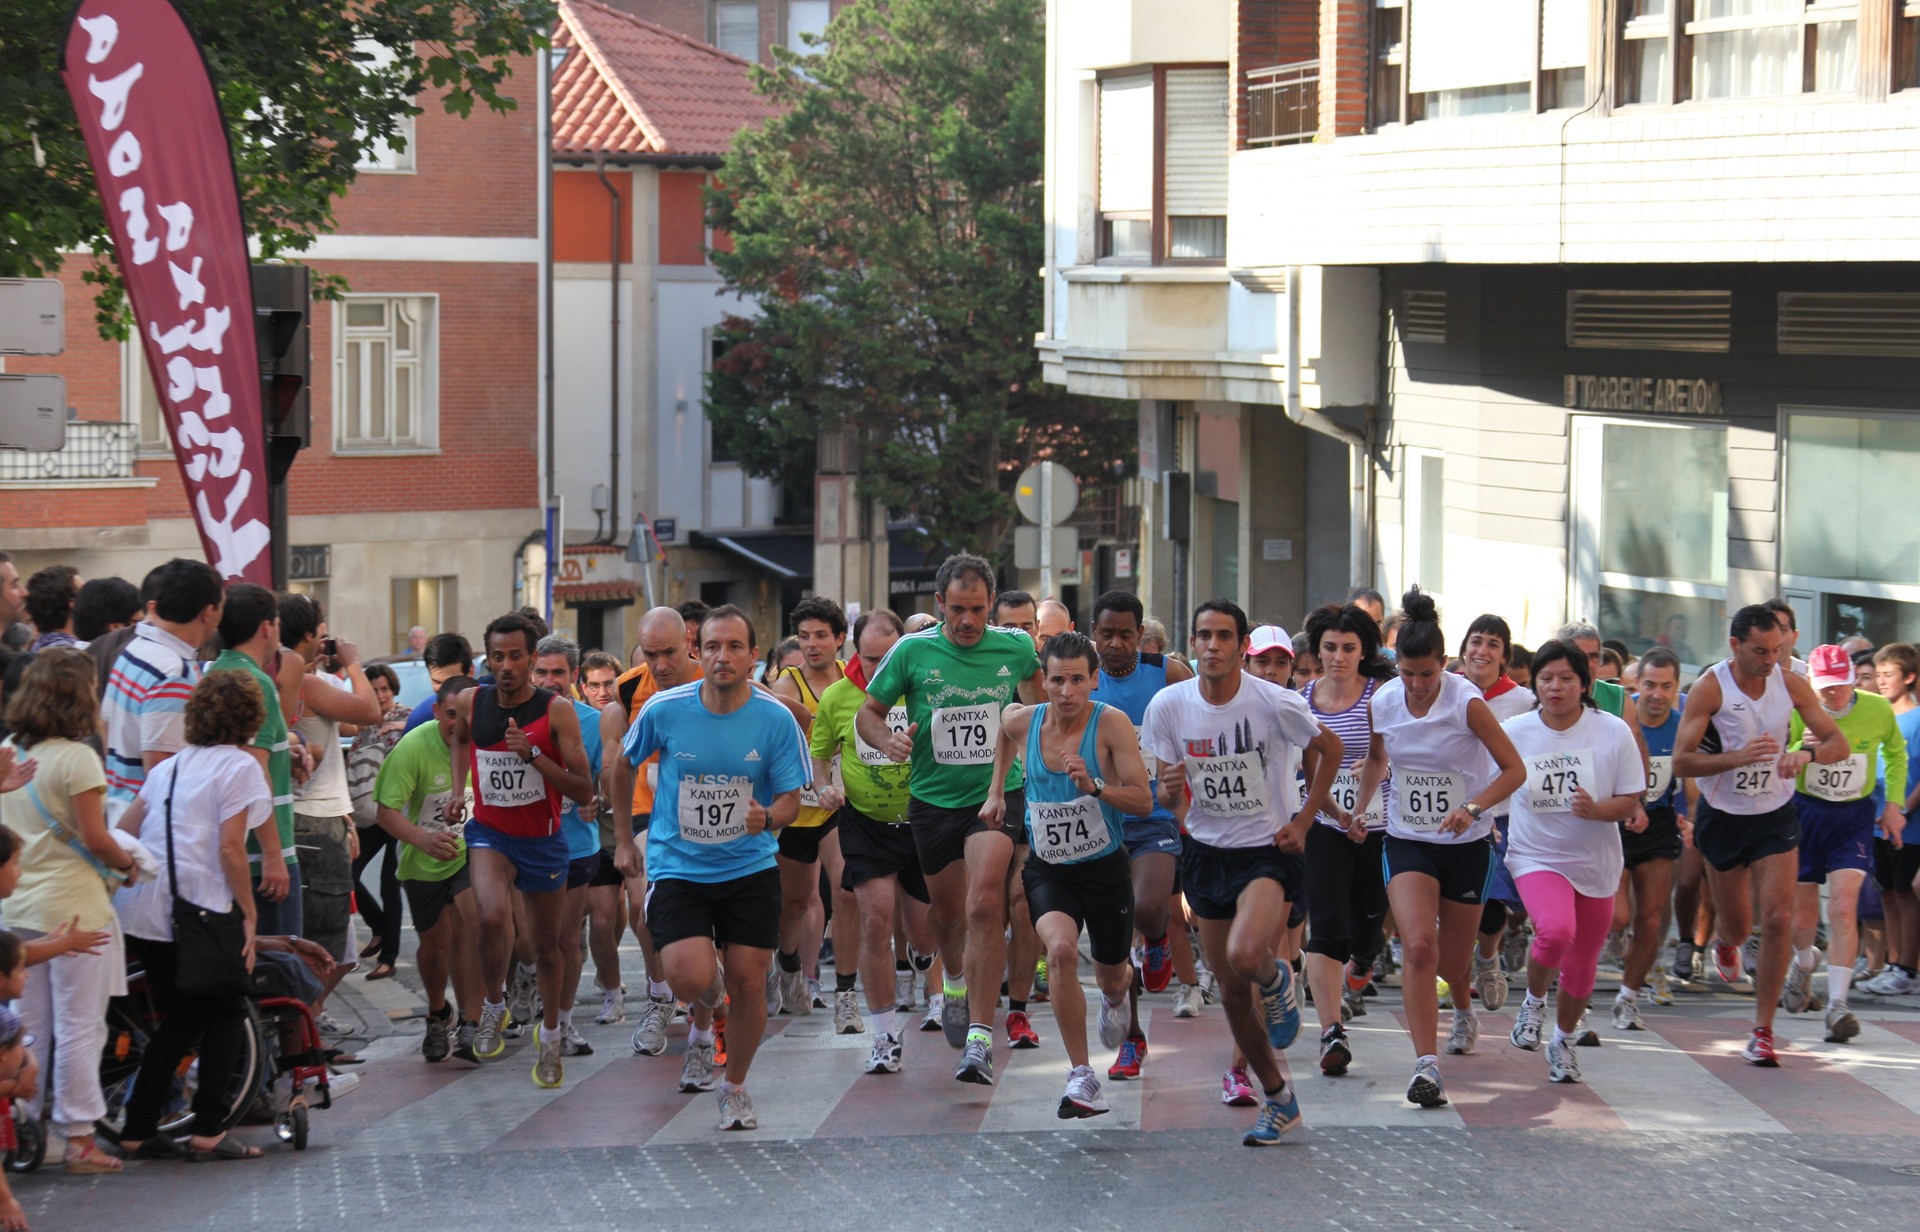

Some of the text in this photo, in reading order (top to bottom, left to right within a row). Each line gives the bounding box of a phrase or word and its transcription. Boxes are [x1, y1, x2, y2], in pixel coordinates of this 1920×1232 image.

[888, 711, 907, 722] TXA
[941, 710, 989, 723] KANTXA
[947, 724, 987, 747] 179
[485, 756, 528, 767] KANTXA
[937, 750, 967, 760] KIROL
[1197, 760, 1248, 774] KANTXA
[1534, 756, 1582, 771] KANTXA
[489, 769, 526, 791] 607
[1406, 775, 1453, 787] KANTXA
[1542, 770, 1579, 795] 473
[1736, 770, 1771, 790] 247
[1817, 769, 1852, 788] 307
[690, 788, 740, 800] KANTXA
[1204, 775, 1247, 799] 644
[484, 789, 541, 802] KIROL MODA
[800, 793, 817, 802] ROL
[1332, 788, 1358, 810] 16
[1410, 790, 1449, 813] 615
[1532, 797, 1561, 808] KIROL
[1038, 804, 1088, 819] KANTXA
[1199, 798, 1263, 812] KIROL MODA
[694, 802, 736, 826] 197
[1402, 815, 1446, 825] KIROL MO
[683, 824, 746, 839] KIROL MODA
[1046, 819, 1089, 846] 574
[1040, 837, 1106, 859] KIROL MODA
